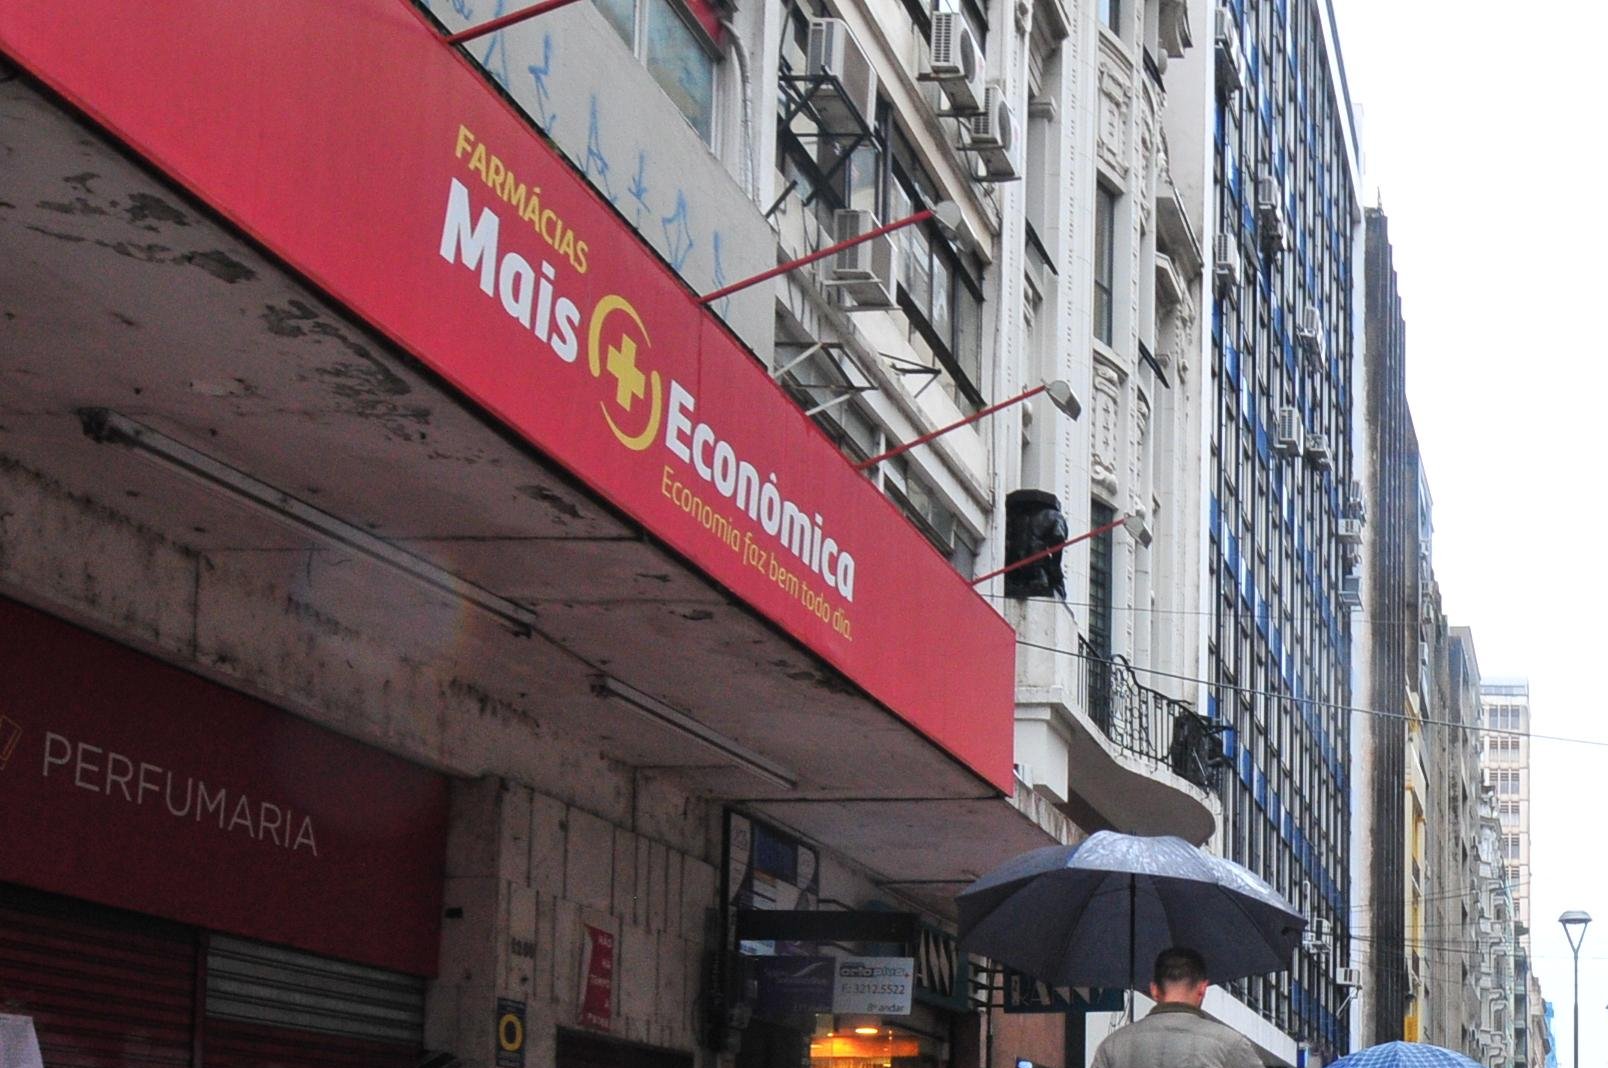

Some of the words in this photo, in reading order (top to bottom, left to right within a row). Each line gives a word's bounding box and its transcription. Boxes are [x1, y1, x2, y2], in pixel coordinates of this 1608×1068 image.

[439, 176, 582, 364] Mais
[455, 123, 589, 274] FARMÁCIAS
[661, 465, 741, 553] Economia
[743, 531, 766, 573] faz
[769, 552, 800, 595] bem
[800, 579, 830, 624] todo
[832, 597, 854, 642] dia.
[665, 379, 856, 603] Econômica
[42, 731, 318, 856] PERFUMARIA
